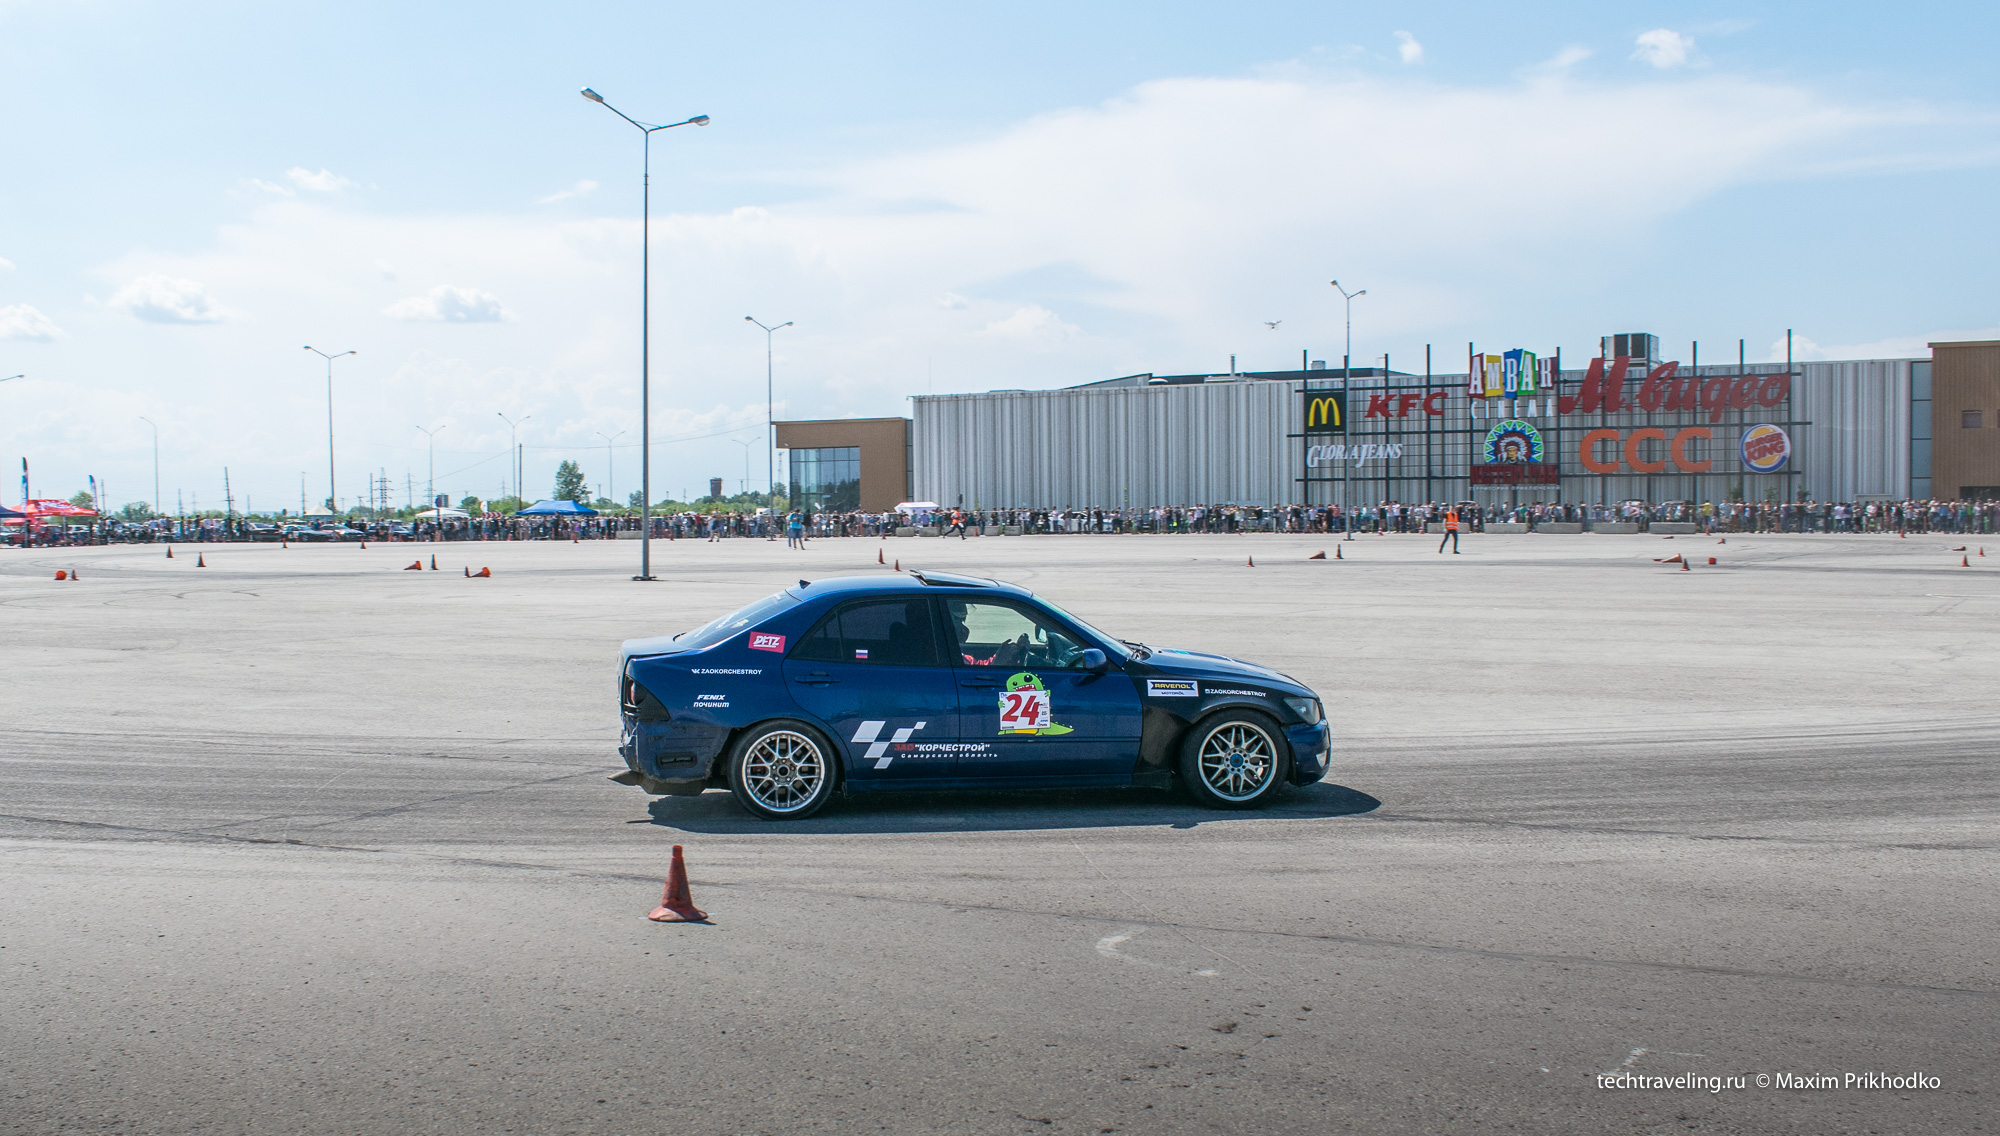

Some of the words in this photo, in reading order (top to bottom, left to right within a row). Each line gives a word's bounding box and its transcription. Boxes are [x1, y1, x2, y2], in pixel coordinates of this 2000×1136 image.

[1468, 355, 1553, 395] AMBAR
[1364, 391, 1448, 418] KFC
[1470, 399, 1554, 419] CINEMA
[1745, 432, 1783, 452] BURGER
[1746, 440, 1785, 463] KING
[1355, 443, 1403, 468] JEANS
[1210, 688, 1266, 698] ZAOKORCHESTROY
[1001, 693, 1041, 726] 24
[894, 743, 914, 751] ЗАО
[914, 743, 990, 752] "КОРЧЕСТРОЙ"
